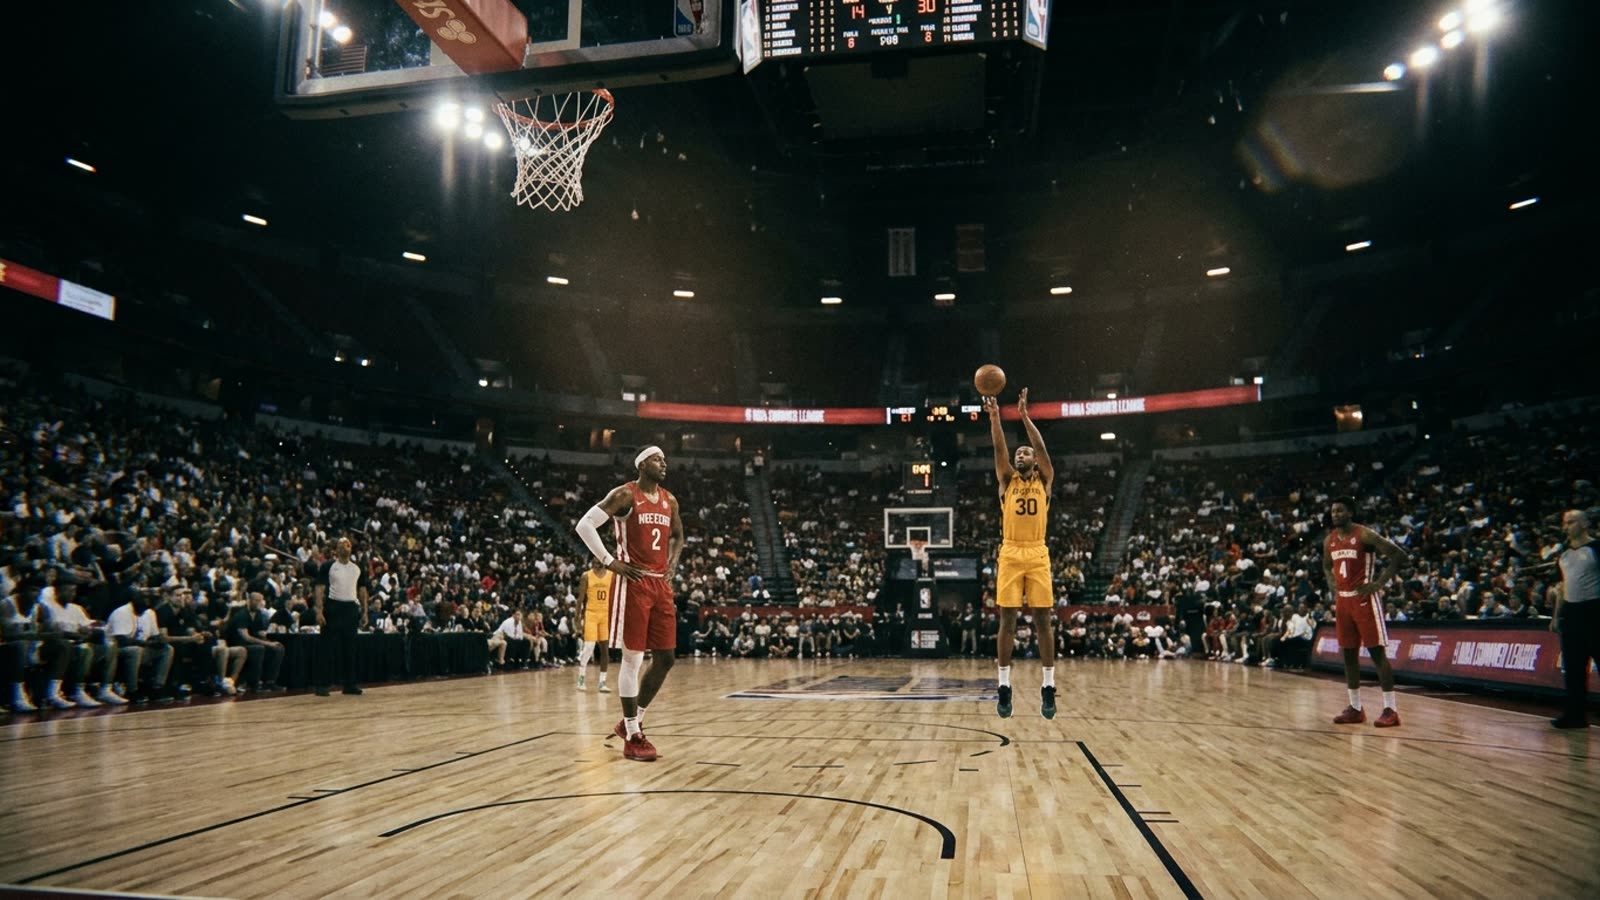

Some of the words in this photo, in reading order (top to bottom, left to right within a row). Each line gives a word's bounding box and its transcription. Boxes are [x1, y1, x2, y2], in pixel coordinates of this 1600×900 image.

[851, 4, 865, 19] 14
[917, 0, 936, 13] 30
[1015, 497, 1038, 516] 30
[651, 527, 661, 551] 2
